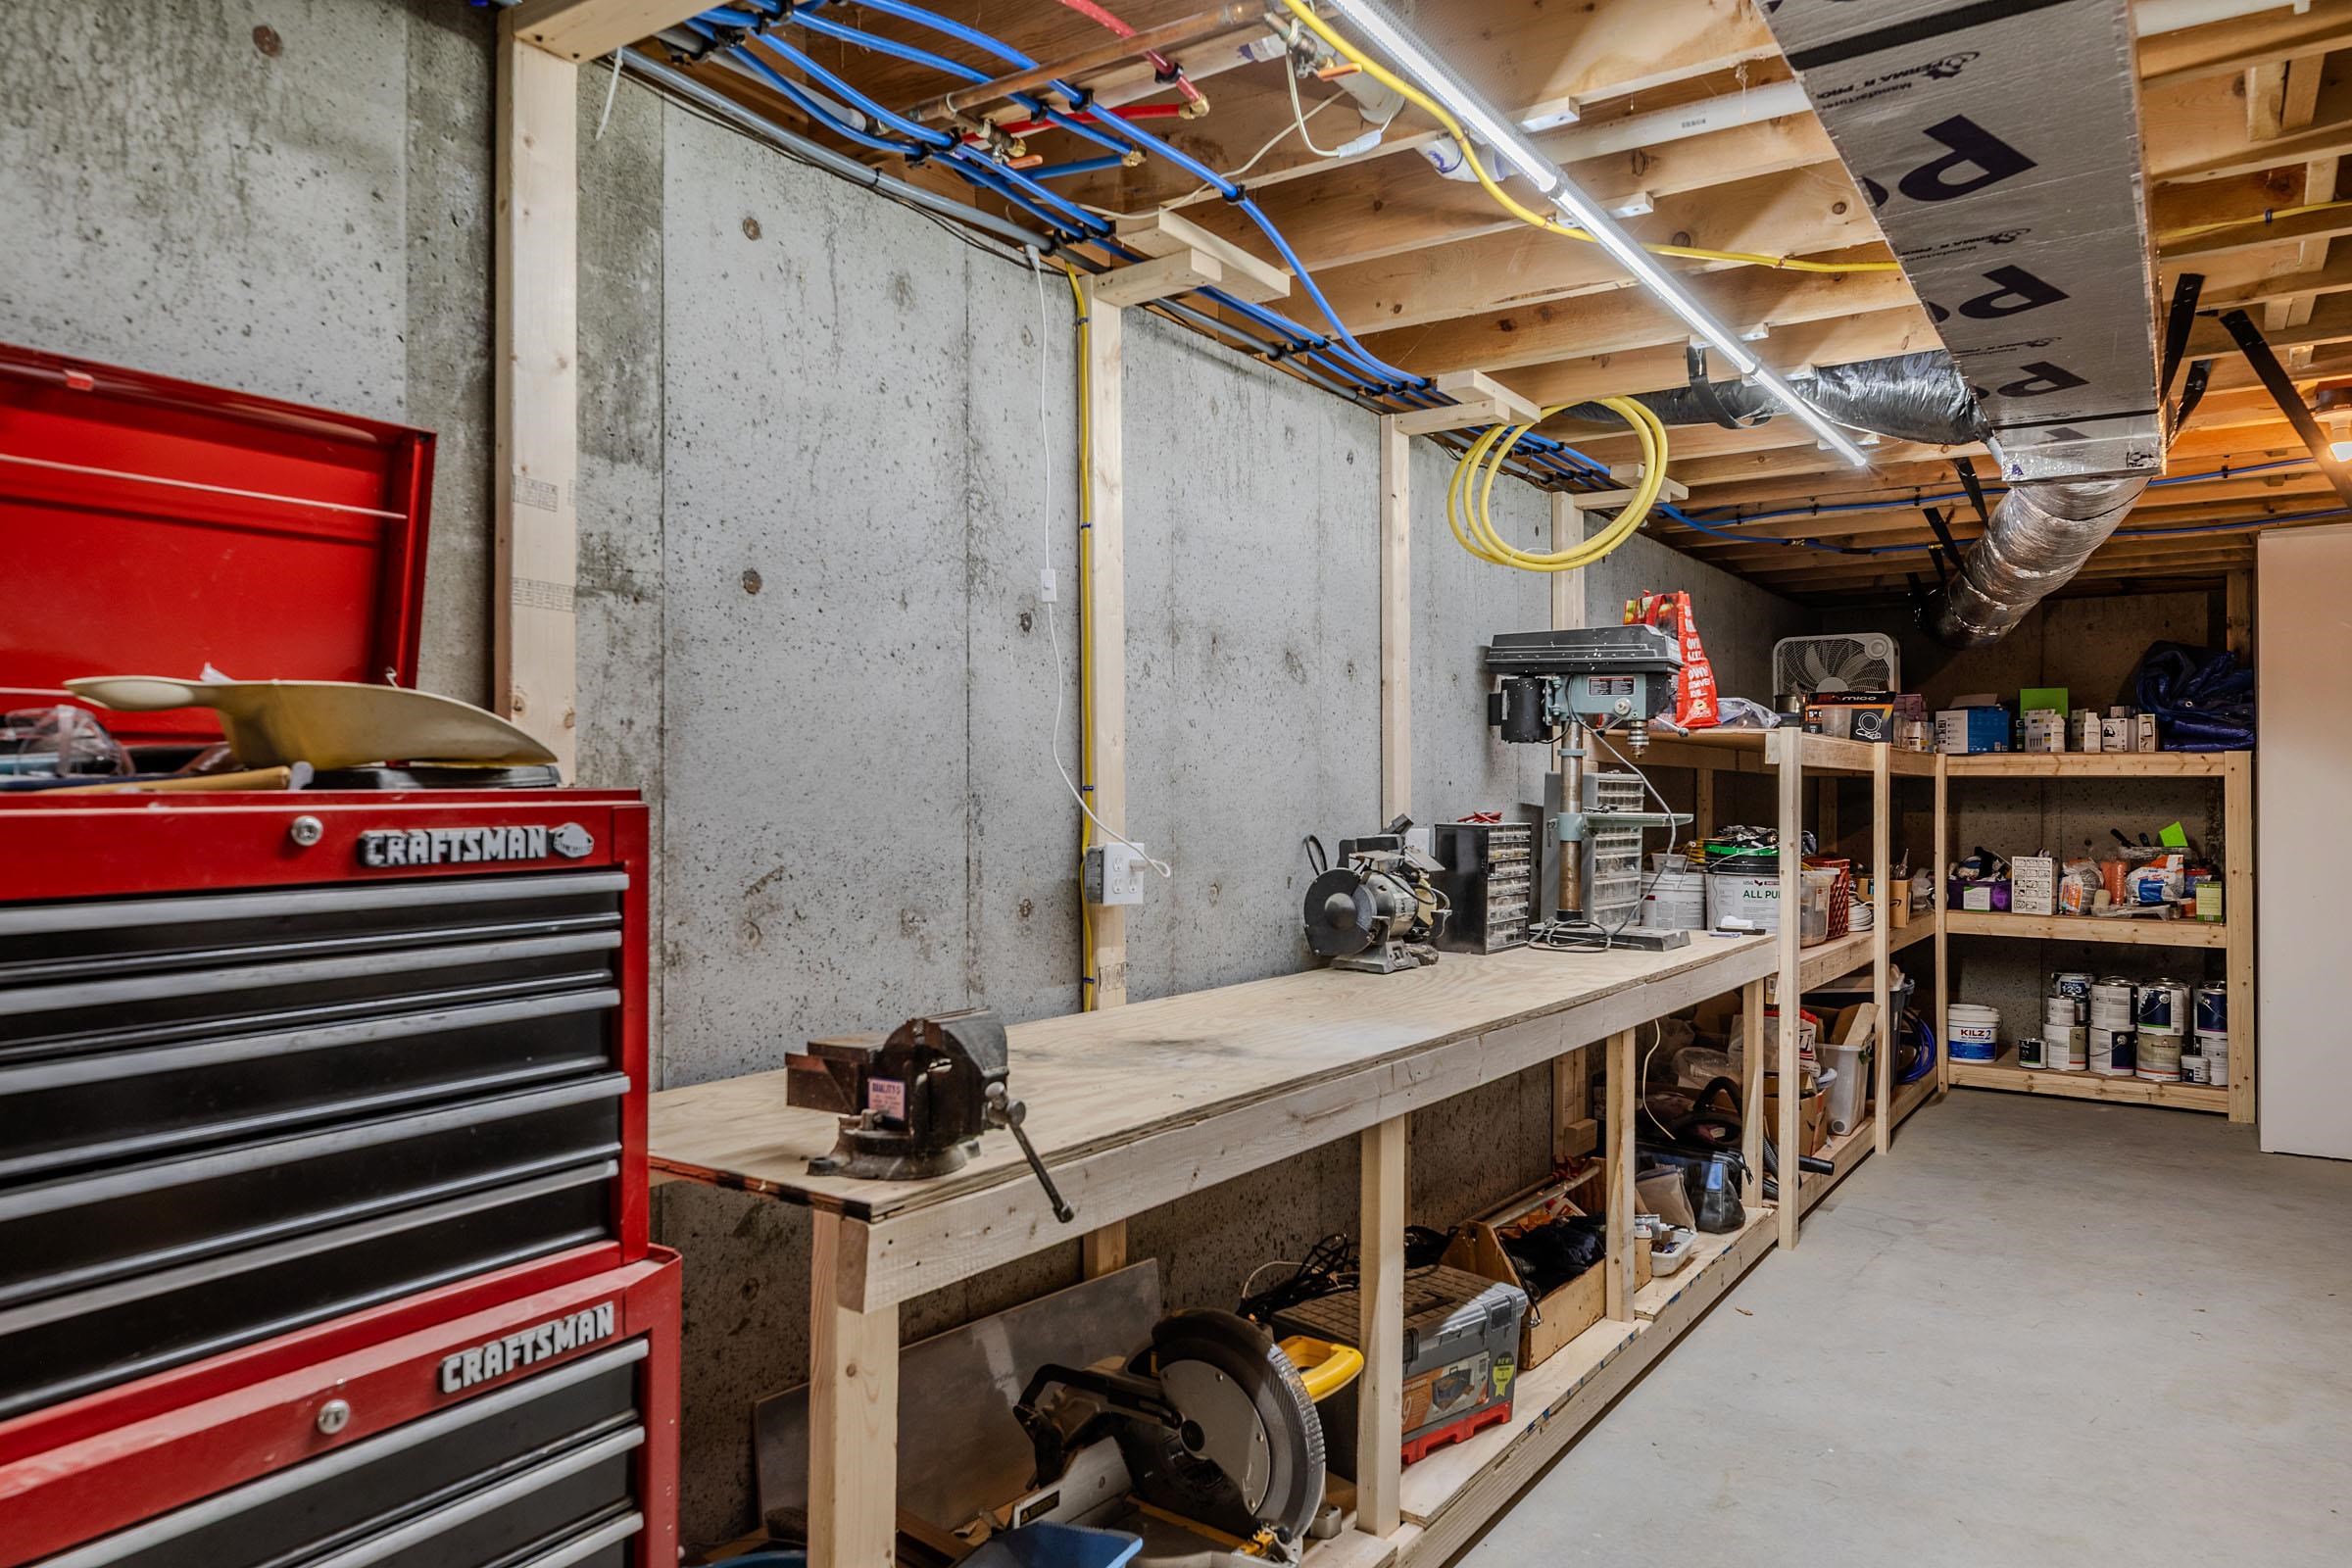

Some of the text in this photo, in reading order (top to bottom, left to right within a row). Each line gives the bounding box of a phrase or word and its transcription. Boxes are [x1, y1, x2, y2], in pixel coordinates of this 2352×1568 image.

[361, 825, 548, 865] CRAFTSMAN
[1742, 890, 1763, 899] ALL
[1984, 1029, 1991, 1040] 2
[442, 1301, 614, 1394] CRAFTSMAN
